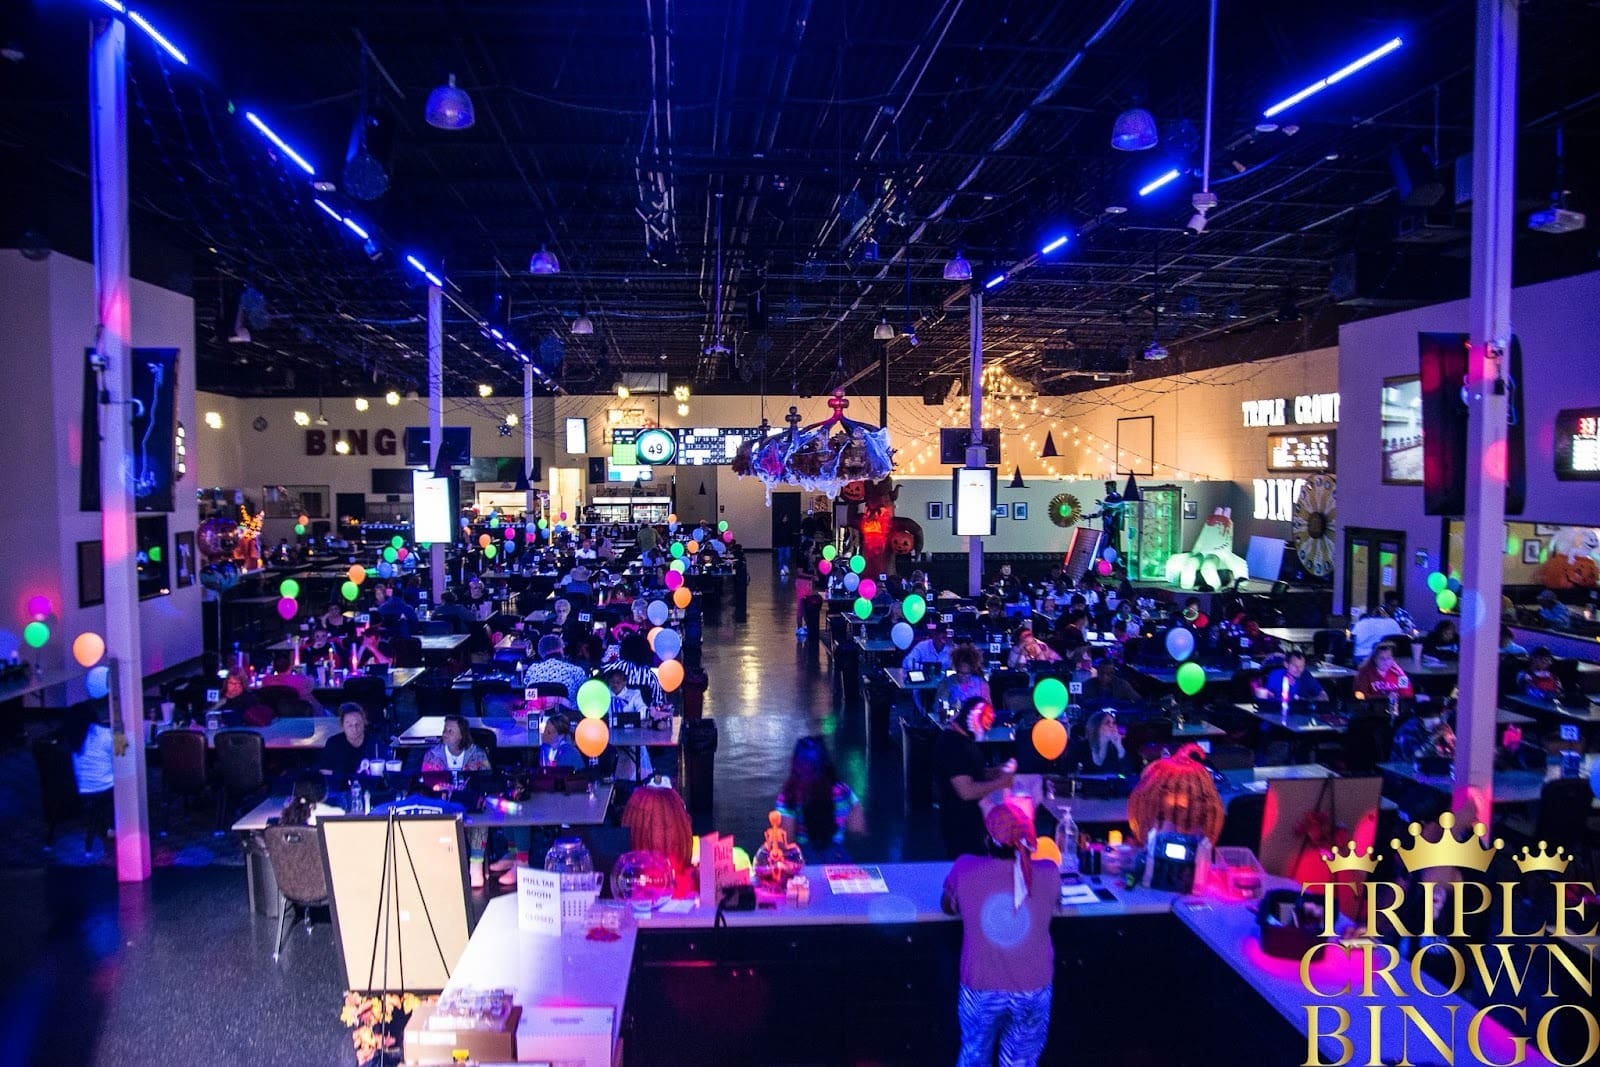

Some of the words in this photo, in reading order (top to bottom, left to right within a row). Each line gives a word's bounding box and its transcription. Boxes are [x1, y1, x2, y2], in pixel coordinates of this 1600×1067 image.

[1241, 398, 1285, 427] TRIPLE
[306, 428, 407, 456] BING
[648, 443, 663, 455] 49
[526, 690, 537, 699] 46
[523, 877, 541, 886] PULL
[526, 889, 551, 899] BOOTH
[524, 912, 554, 924] CLOSED
